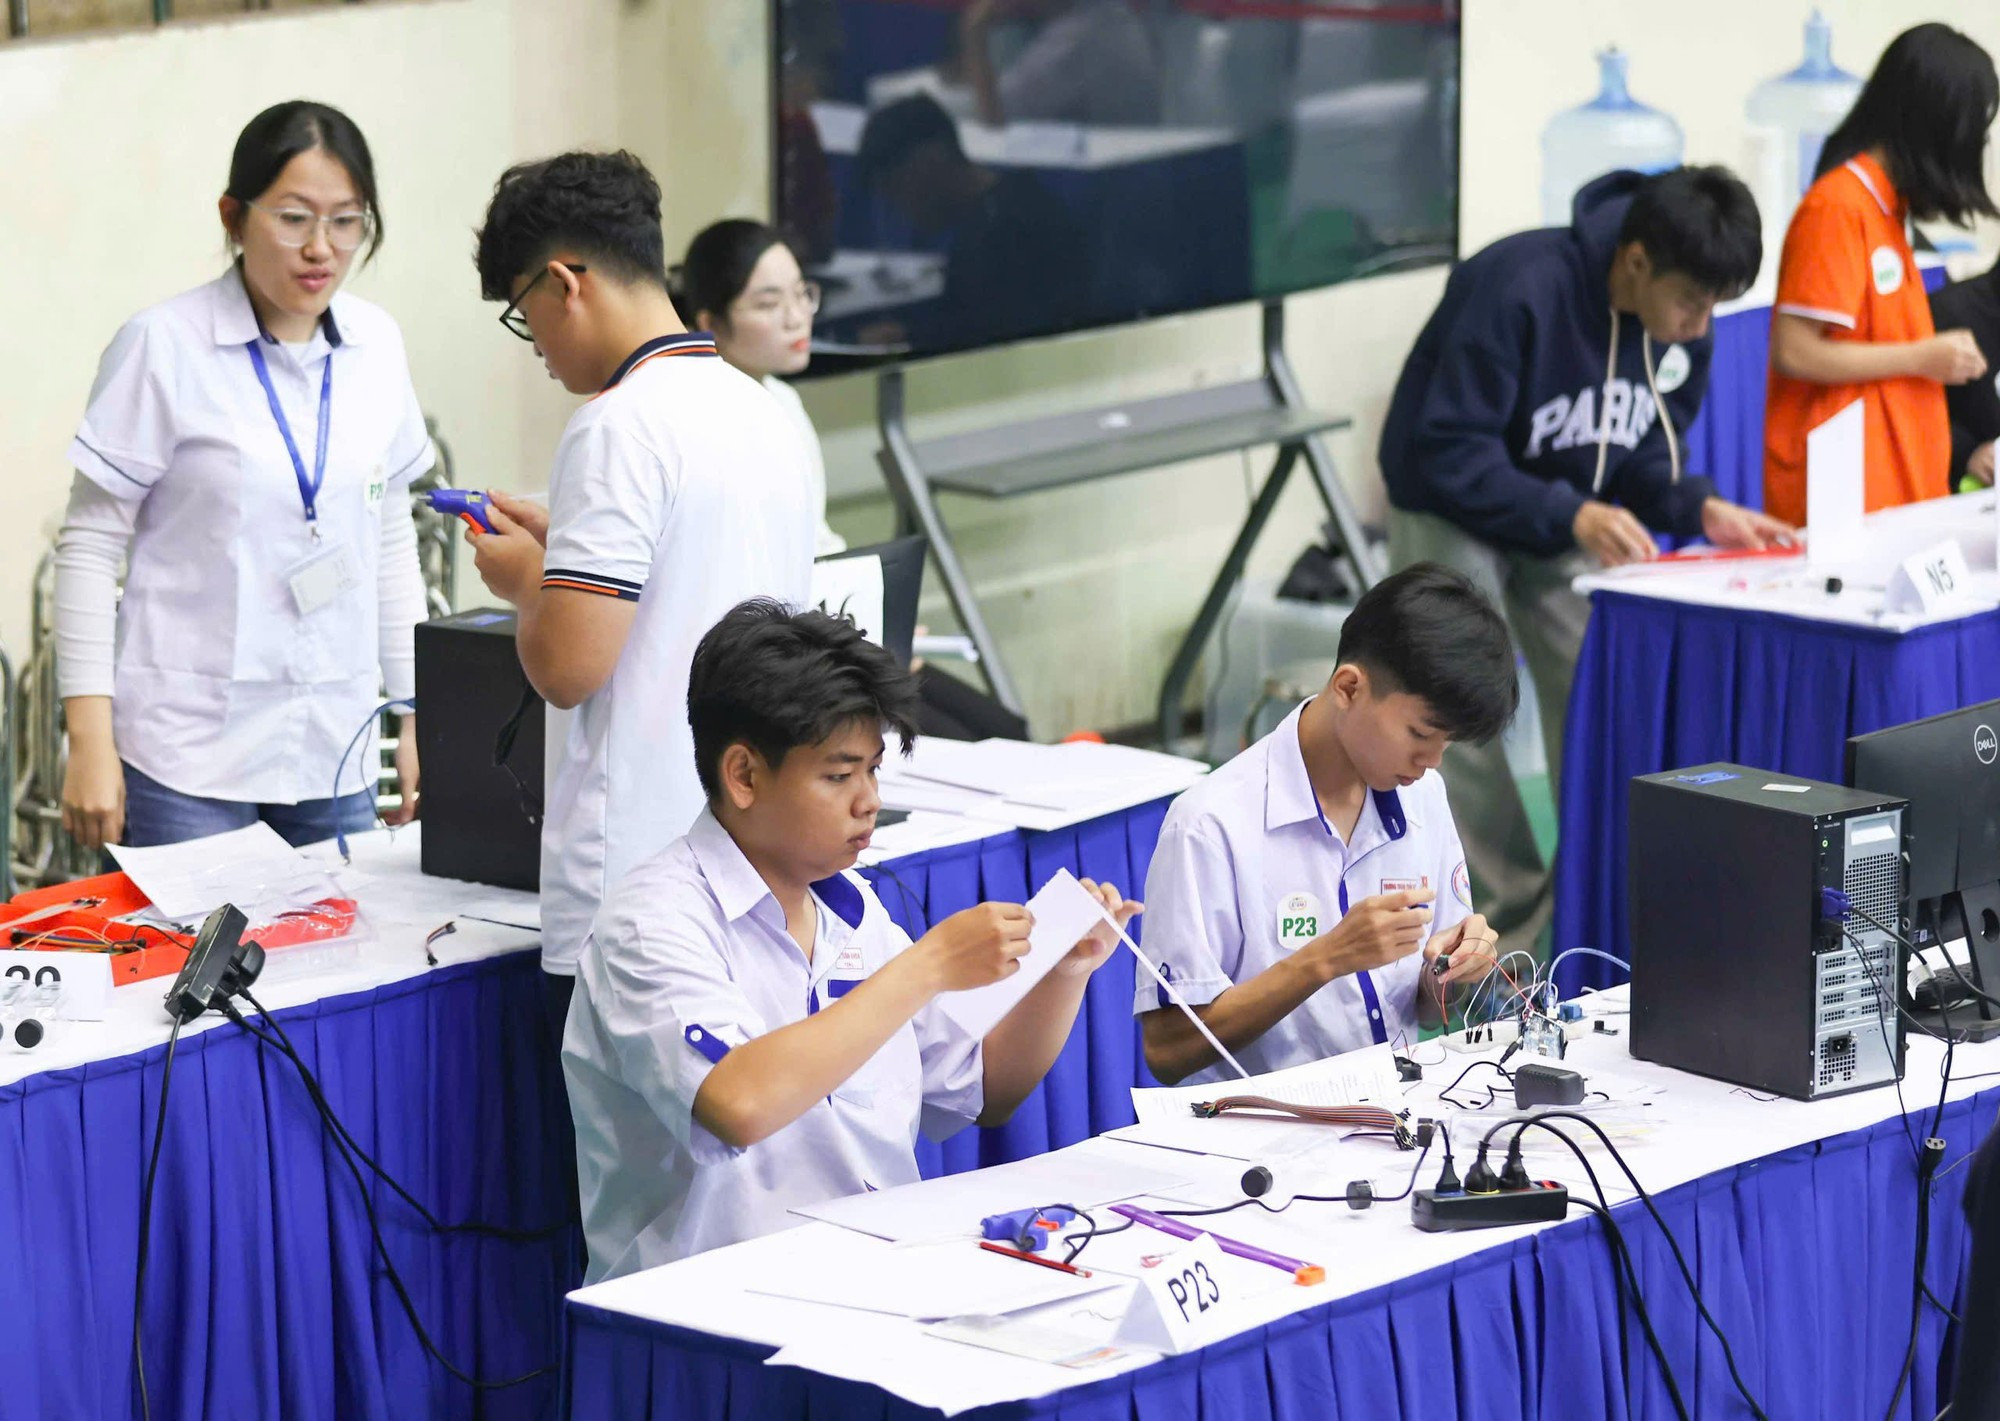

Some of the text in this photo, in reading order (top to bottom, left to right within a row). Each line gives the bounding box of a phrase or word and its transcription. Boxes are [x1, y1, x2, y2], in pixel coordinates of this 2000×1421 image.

[370, 482, 384, 500] P2
[1924, 558, 1954, 596] N5
[1977, 737, 1995, 751] DELL
[1282, 916, 1317, 937] P23
[1166, 1260, 1220, 1323] P23
